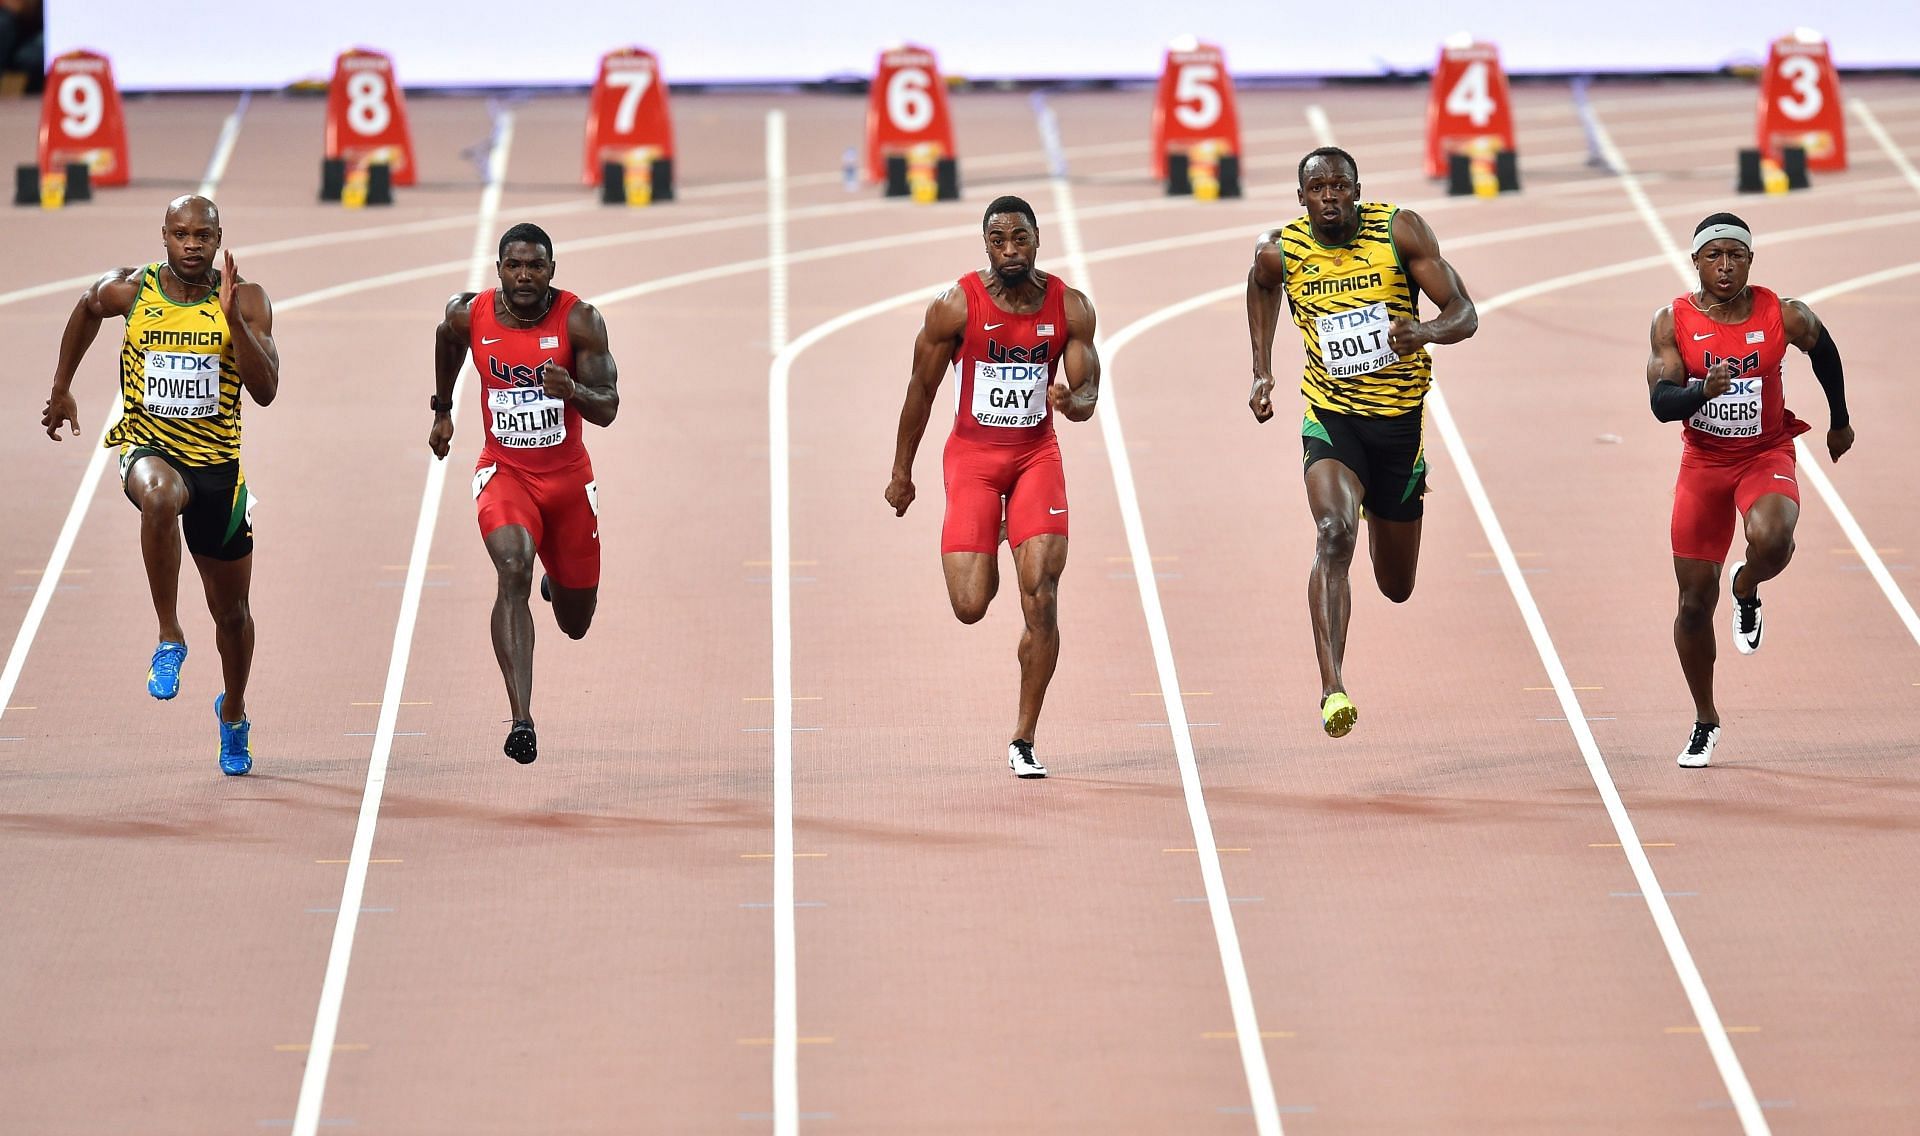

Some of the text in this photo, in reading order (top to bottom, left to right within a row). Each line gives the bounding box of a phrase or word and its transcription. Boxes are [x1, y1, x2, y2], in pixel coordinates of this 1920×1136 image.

[1174, 64, 1223, 129] 5
[1446, 62, 1496, 126] 4
[1778, 56, 1823, 121] 3
[58, 75, 103, 138] 9
[346, 72, 390, 136] 8
[605, 70, 653, 134] 7
[886, 69, 934, 132] 6
[1302, 273, 1382, 296] JAMAICA
[1333, 306, 1381, 330] TDK
[139, 331, 223, 346] JAMAICA
[1328, 330, 1382, 361] BOLT
[989, 337, 1049, 364] USA
[165, 355, 213, 370] TDK
[997, 366, 1044, 381] TDK
[1331, 353, 1396, 376] BEIJING 2015
[1704, 350, 1760, 379] USA
[147, 376, 215, 399] POWELL
[990, 387, 1034, 409] GAY
[1722, 380, 1755, 396] DK
[148, 403, 215, 416] BEIJING 2015
[496, 408, 560, 432] GATLIN
[976, 413, 1043, 425] BEIJING 2015
[1698, 401, 1758, 421] ODGERS
[1692, 419, 1759, 436] BEIJING 2015
[497, 432, 562, 447] BEIJING 2015
